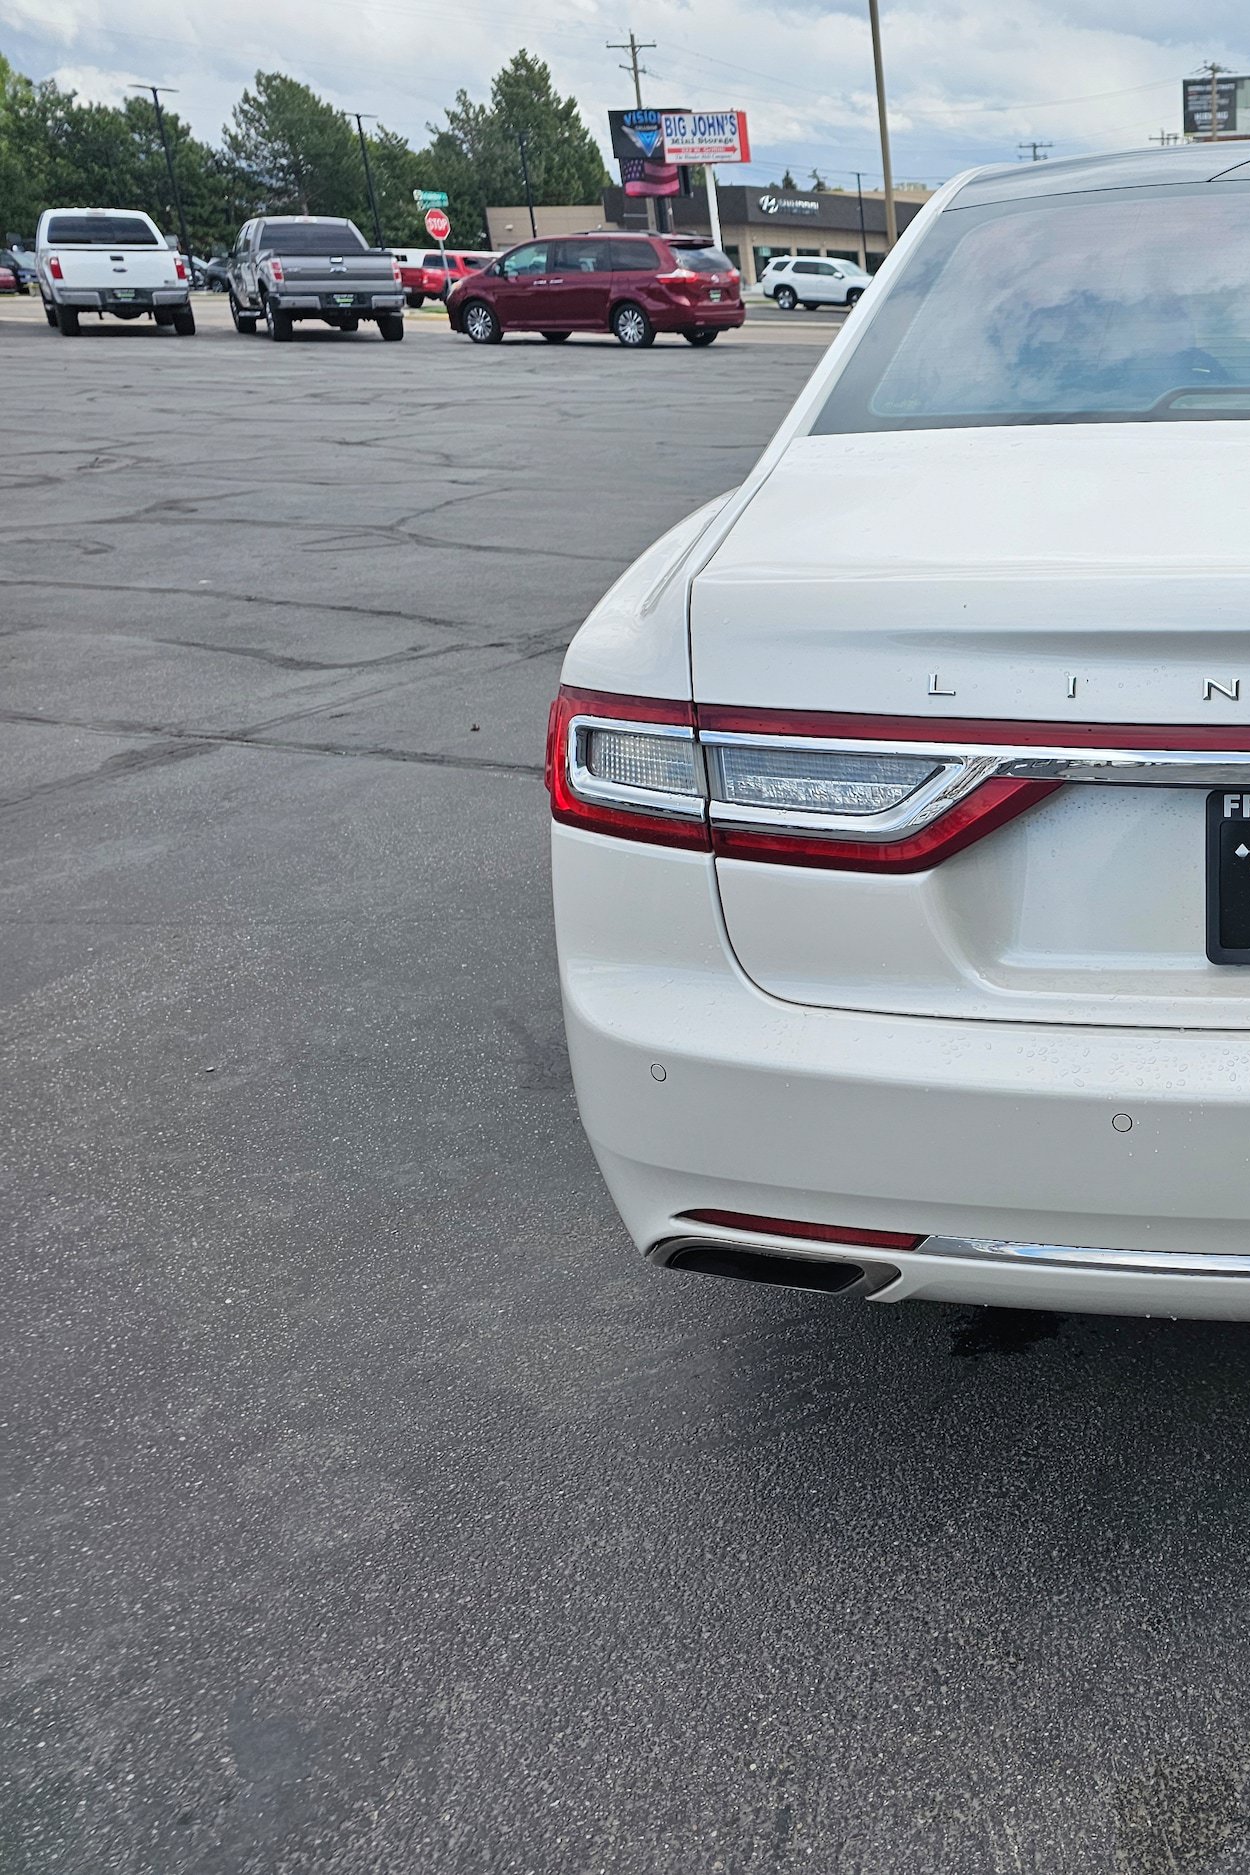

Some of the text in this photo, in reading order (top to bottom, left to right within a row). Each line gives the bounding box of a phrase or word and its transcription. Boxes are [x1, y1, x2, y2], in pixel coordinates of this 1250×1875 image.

[664, 114, 737, 137] BIG JOHN'S
[427, 217, 448, 231] STOP
